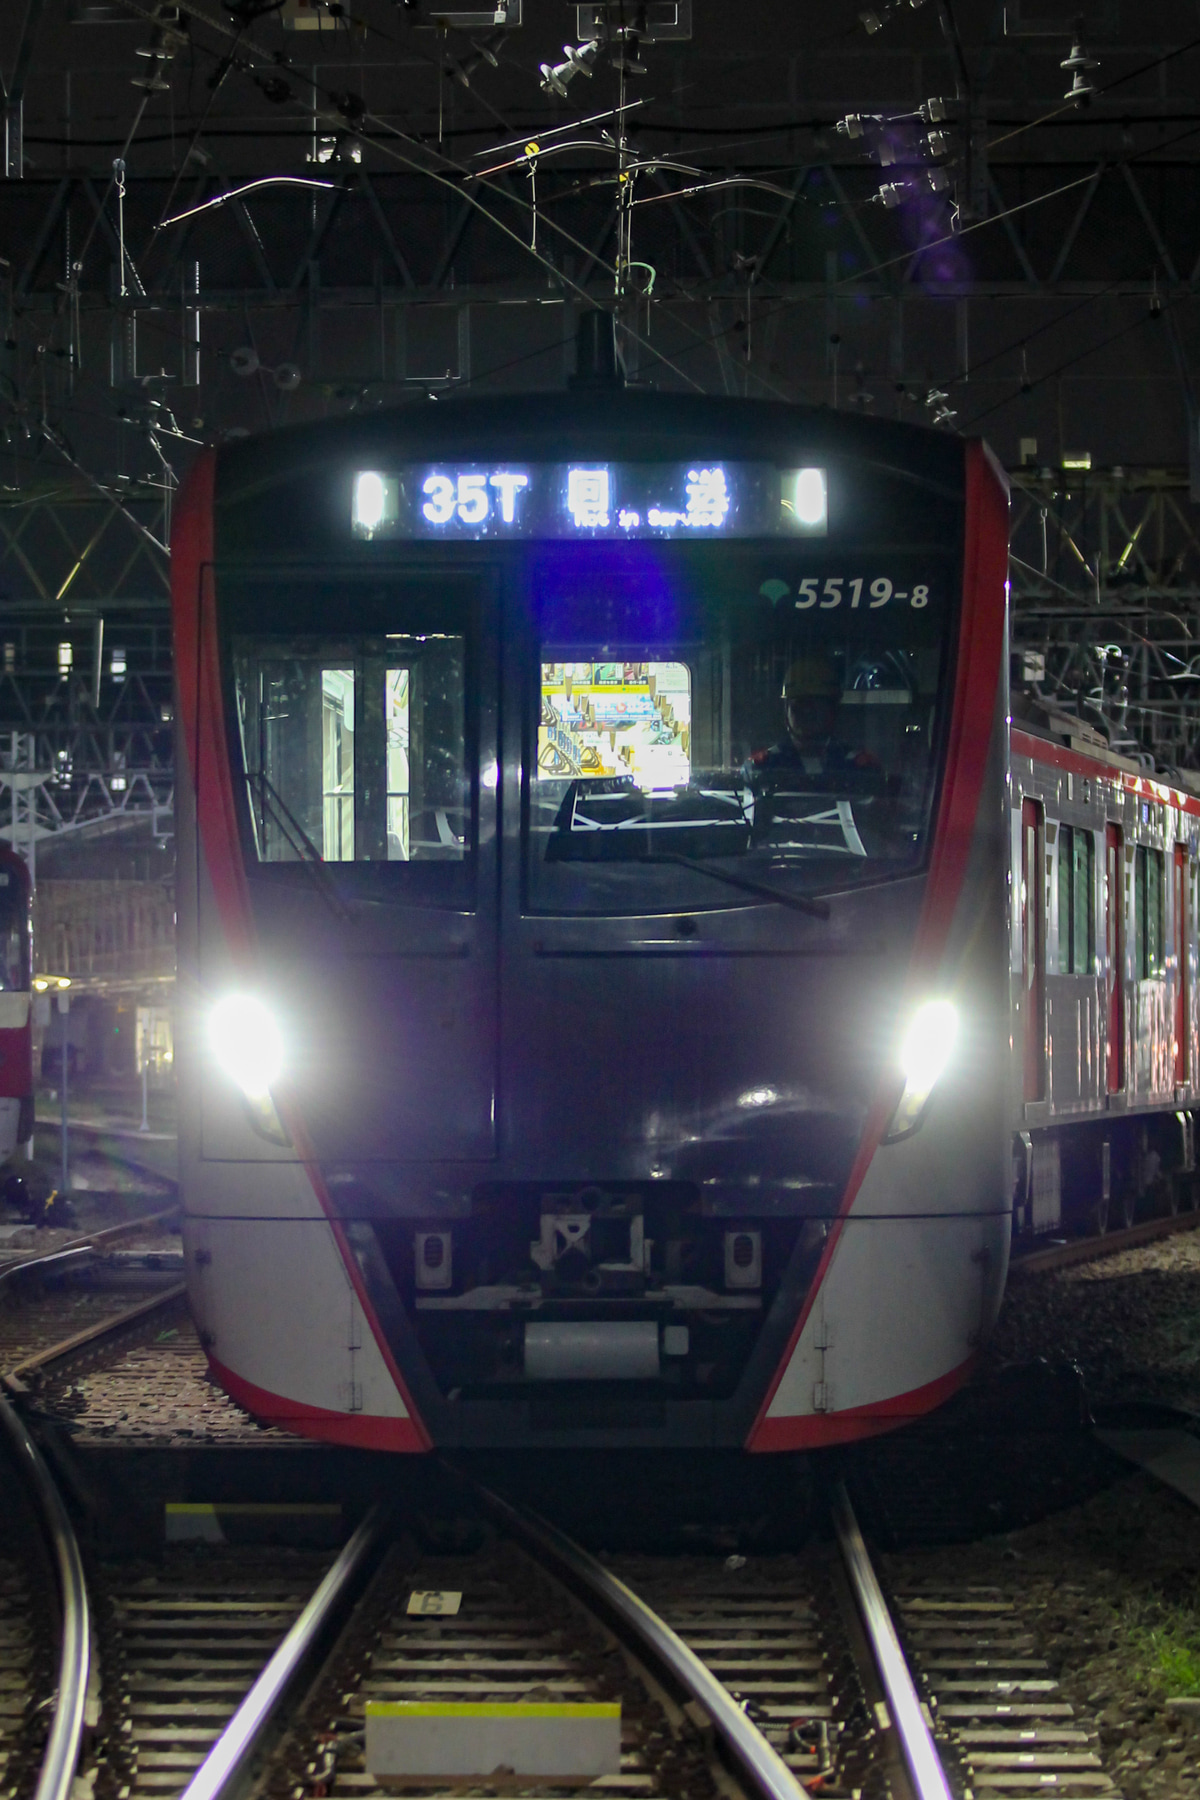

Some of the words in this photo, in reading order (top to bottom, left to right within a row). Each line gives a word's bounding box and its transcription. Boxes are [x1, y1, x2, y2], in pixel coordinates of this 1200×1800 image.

[422, 475, 528, 523] 35T
[619, 509, 639, 526] in
[648, 508, 723, 526] Service
[795, 577, 929, 608] 5519-8
